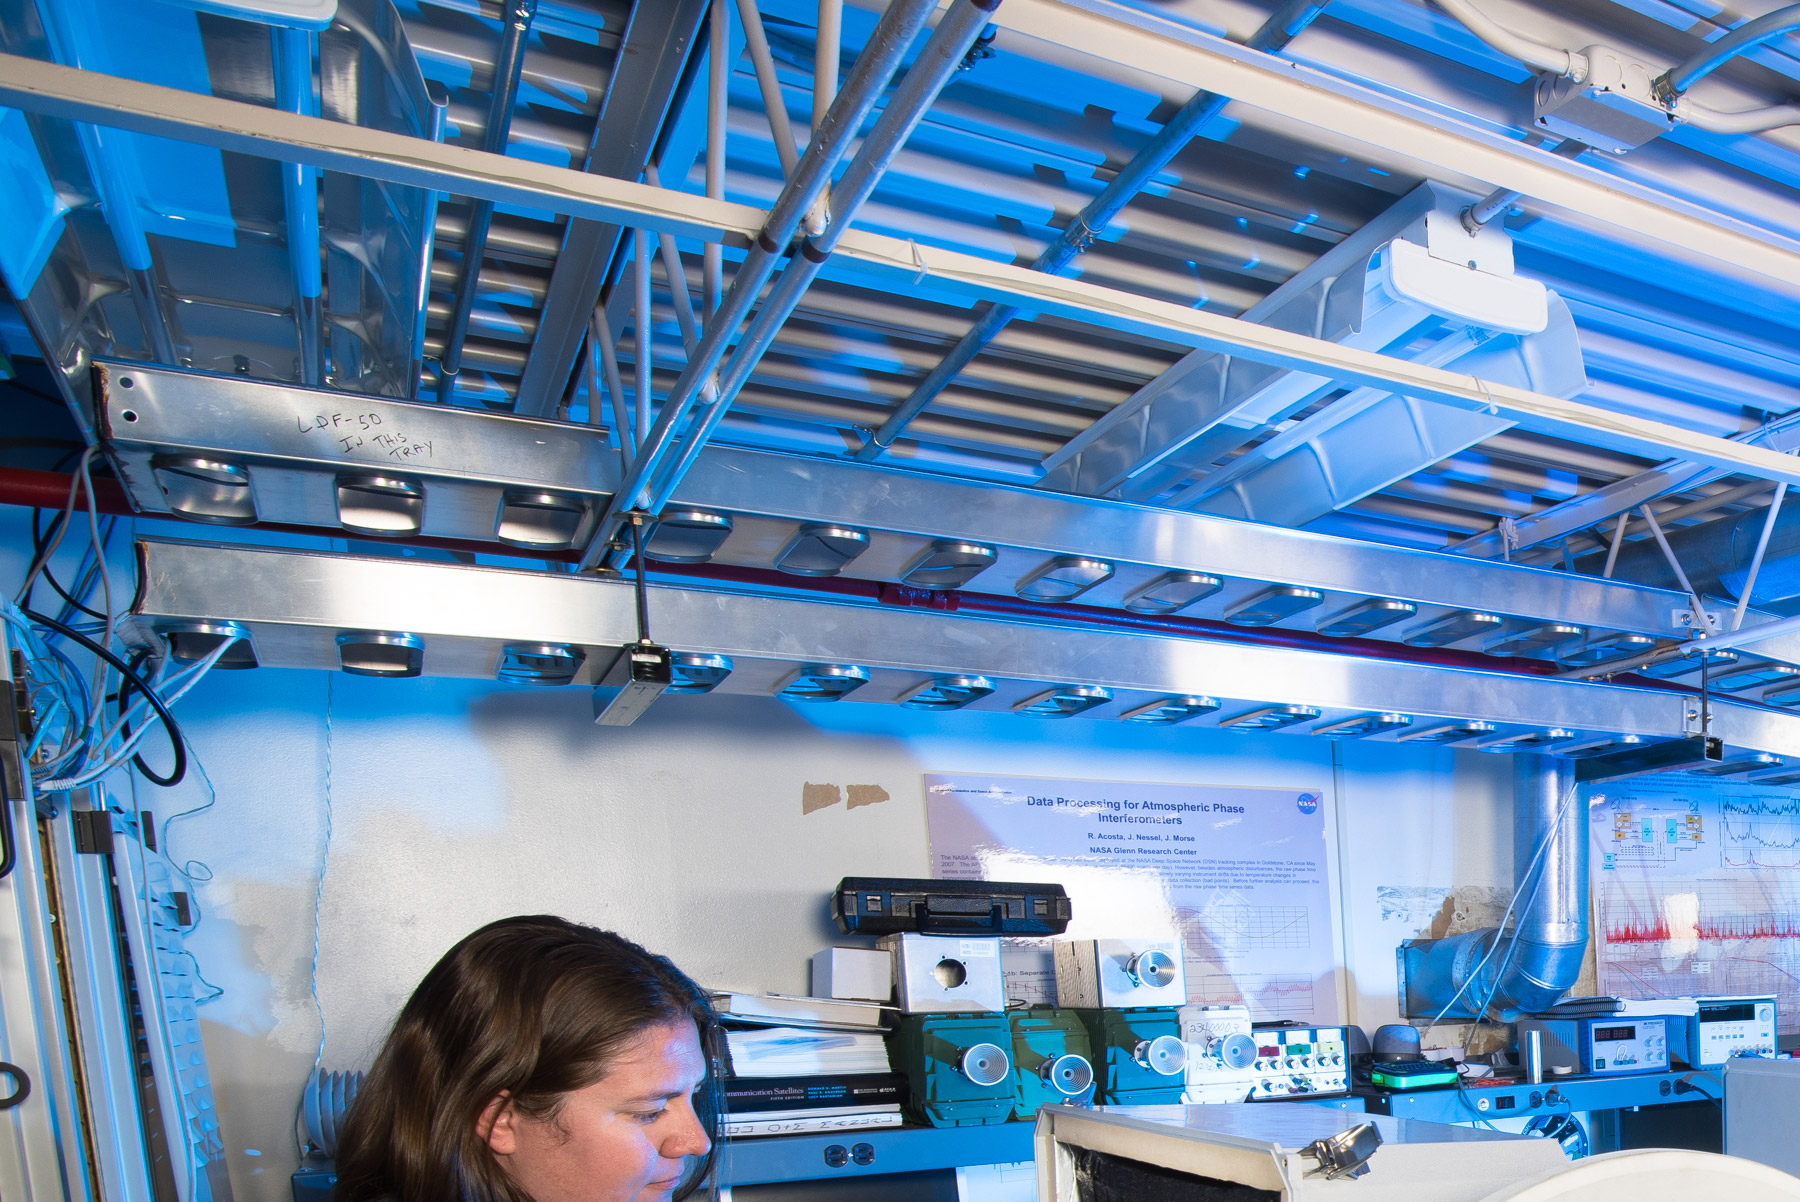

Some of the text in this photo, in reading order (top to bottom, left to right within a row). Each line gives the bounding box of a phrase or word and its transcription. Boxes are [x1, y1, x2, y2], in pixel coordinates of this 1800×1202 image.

[297, 413, 382, 433] LDF-50
[339, 433, 407, 453] IN THIS
[389, 441, 433, 460] TRAY
[1027, 796, 1245, 814] Data Processing for Atmospheric Phase
[1098, 813, 1183, 825] Interferometers
[1098, 833, 1126, 841] Acosta,
[1136, 834, 1163, 842] Nessel,
[1137, 847, 1172, 855] Research
[1173, 848, 1197, 856] Center
[723, 1087, 804, 1098] ommunication Satellites
